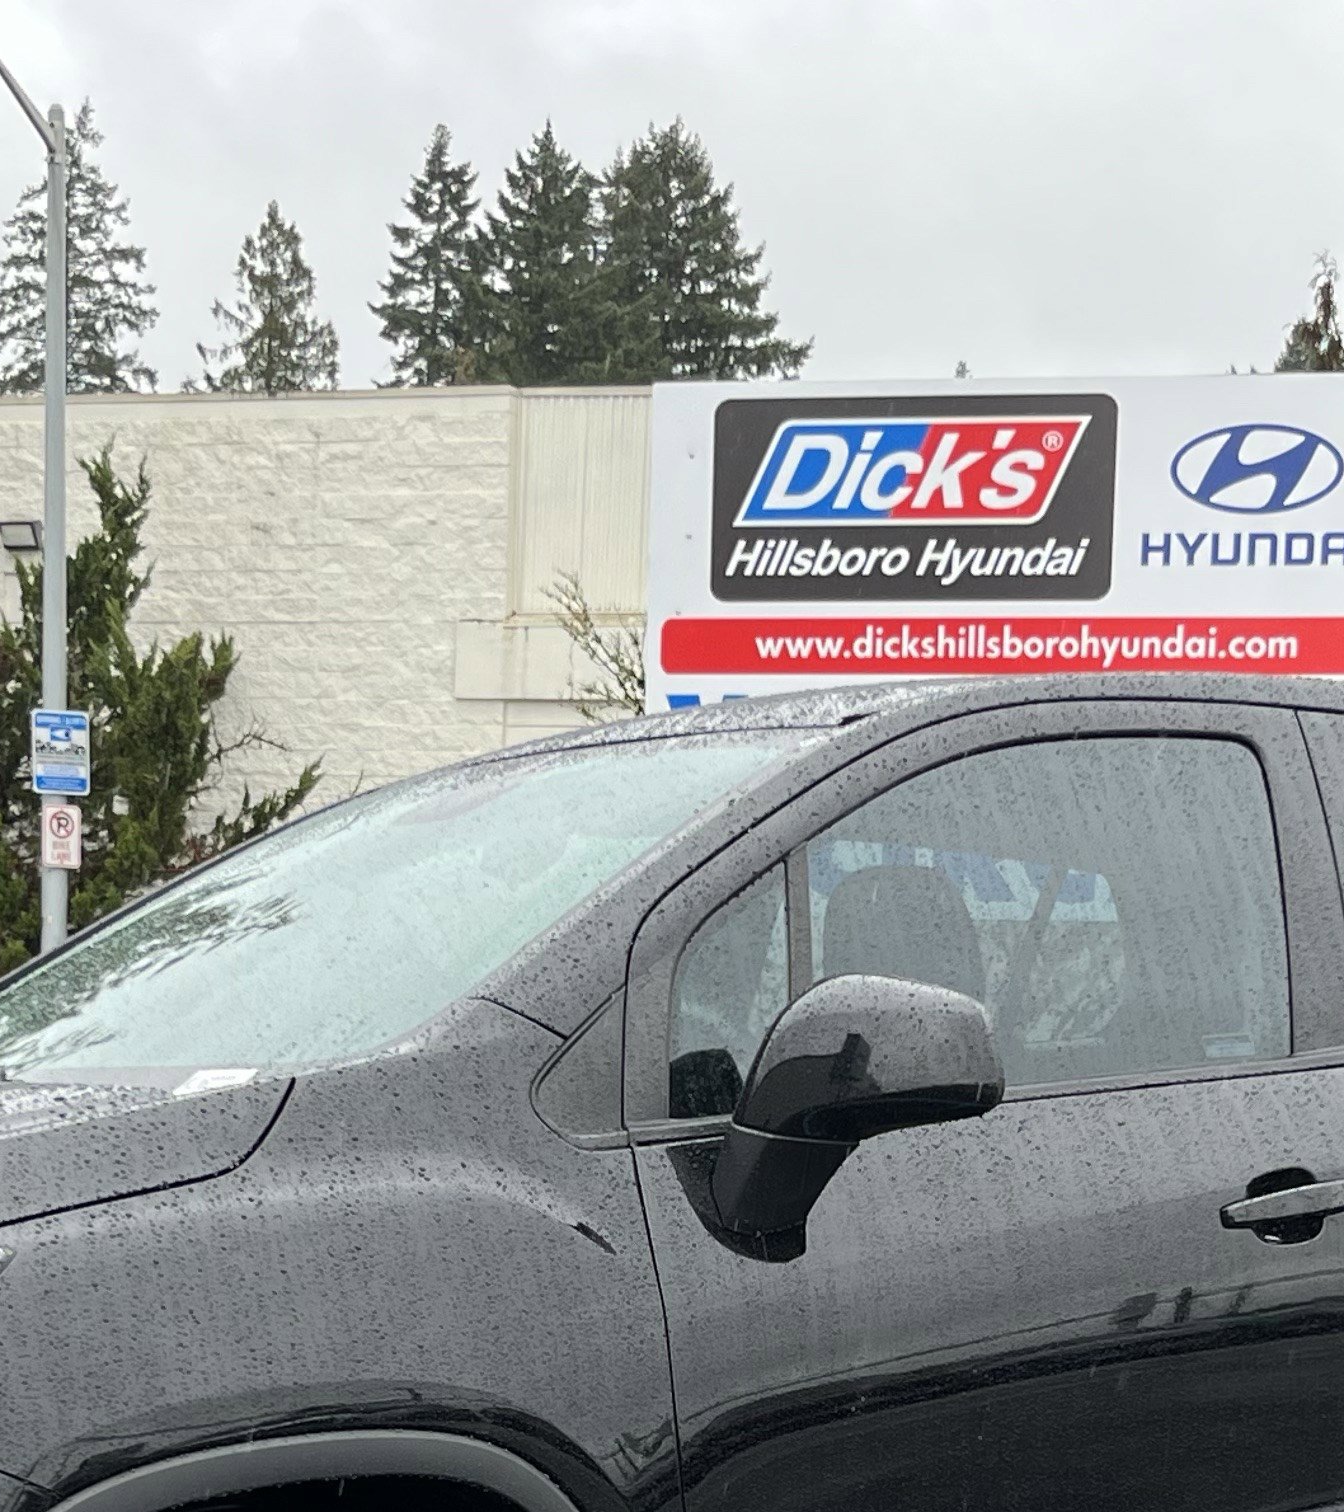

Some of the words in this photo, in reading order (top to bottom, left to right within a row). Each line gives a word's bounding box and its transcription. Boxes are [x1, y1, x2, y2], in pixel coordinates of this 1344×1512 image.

[724, 537, 909, 580] Hillsboro
[916, 537, 1091, 586] Hyundai
[754, 626, 1299, 669] www.dickshillsborohyundai.com
